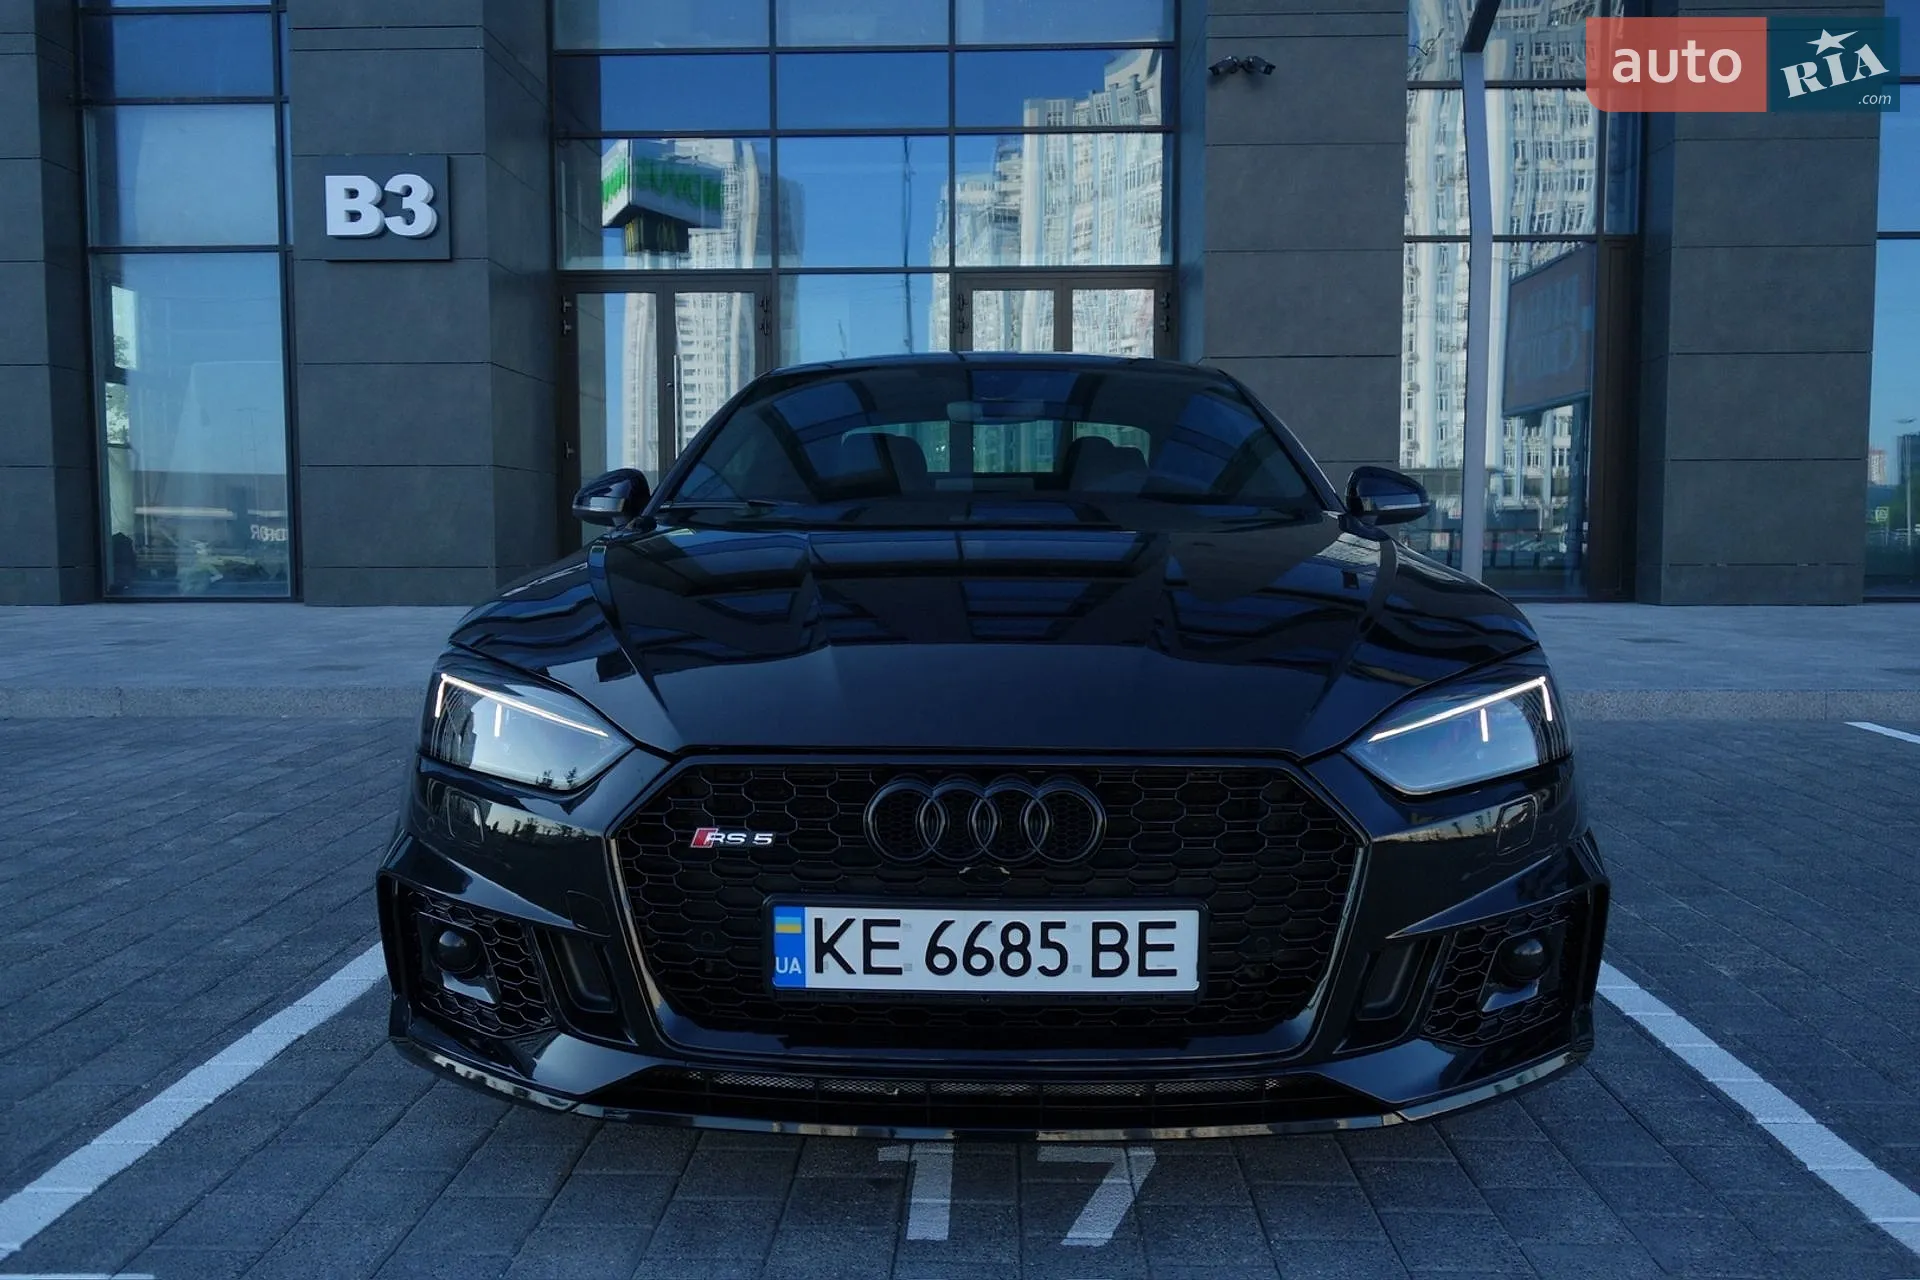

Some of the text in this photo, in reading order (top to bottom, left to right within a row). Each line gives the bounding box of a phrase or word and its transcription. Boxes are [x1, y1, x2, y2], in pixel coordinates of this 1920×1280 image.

[325, 174, 438, 237] B3
[701, 831, 774, 846] RS 5
[775, 957, 802, 975] UA
[814, 917, 1178, 978] KE 6685 BE
